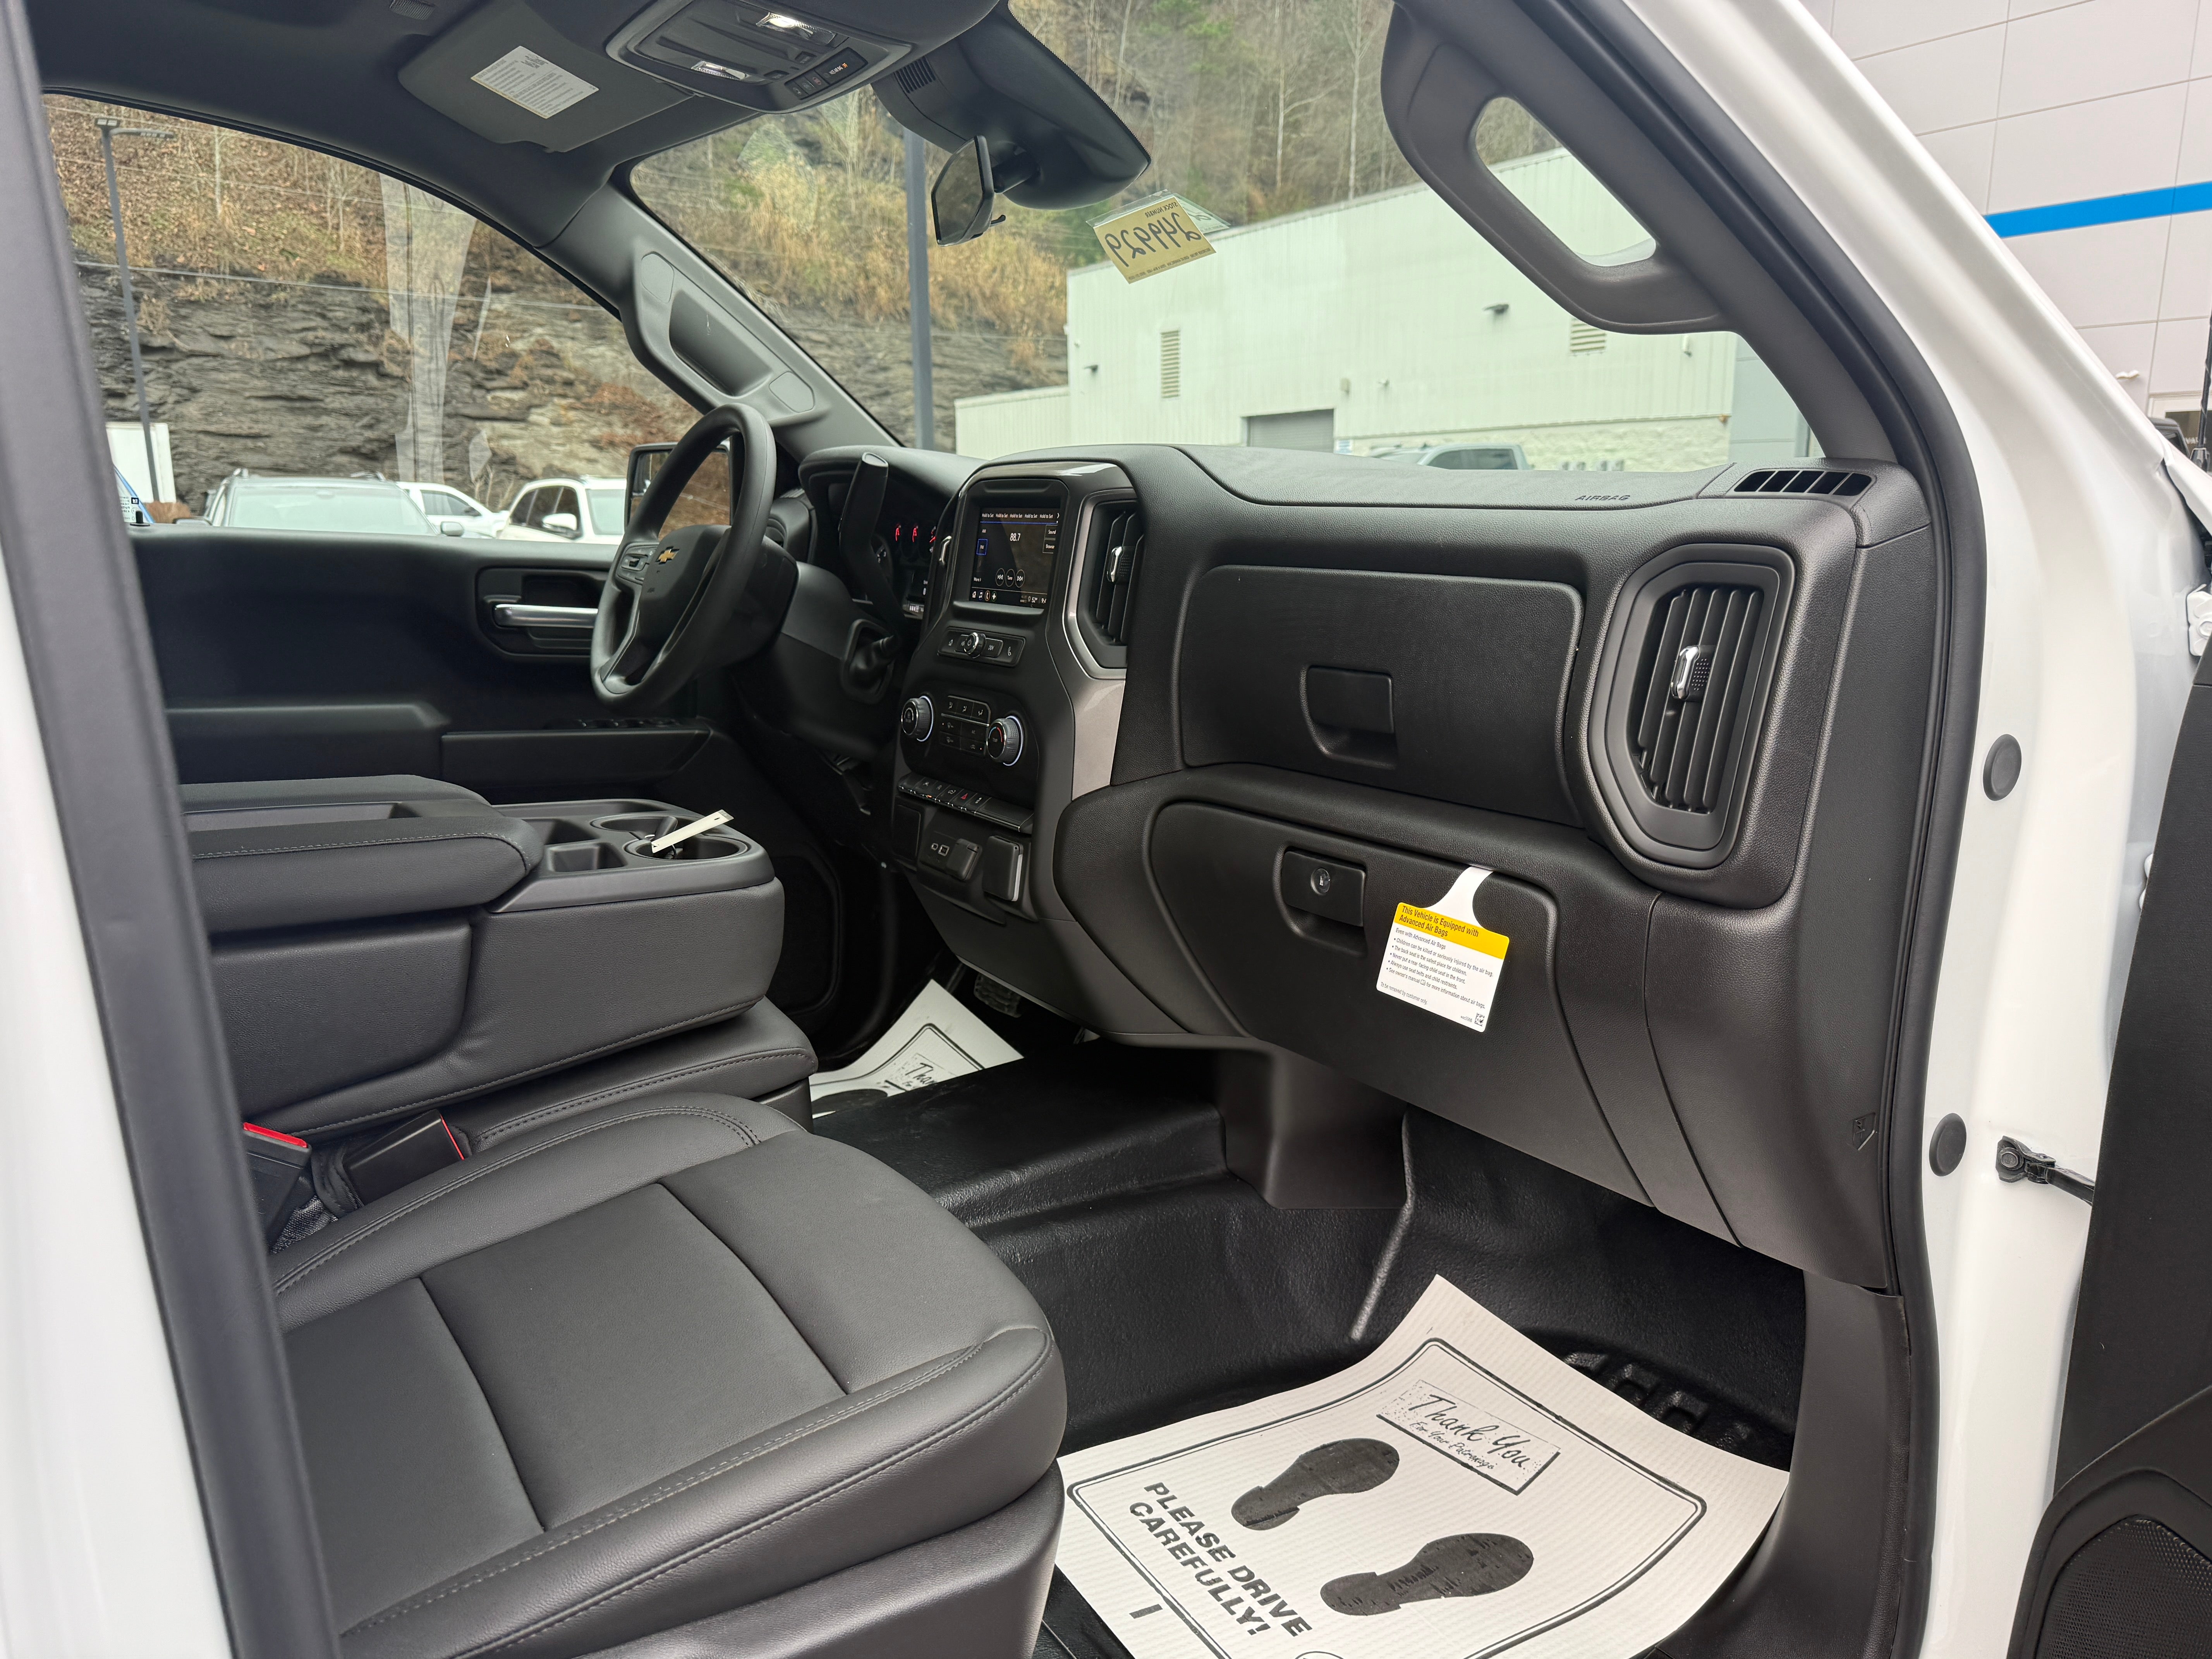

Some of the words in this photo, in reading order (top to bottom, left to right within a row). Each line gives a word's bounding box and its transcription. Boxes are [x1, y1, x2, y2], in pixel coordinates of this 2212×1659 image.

[1010, 533, 1020, 541] 88.7
[1399, 915, 1425, 929] Advanced
[1425, 923, 1434, 931] Air
[1434, 926, 1448, 937] Bags
[1402, 905, 1413, 915] This
[1414, 909, 1433, 922] Vehicle
[1440, 918, 1465, 933] Equipped
[1467, 928, 1479, 937] with
[1413, 934, 1431, 944] Advanced
[1408, 1394, 1500, 1441] Thank
[1487, 1435, 1531, 1468] You
[1410, 1421, 1428, 1432] For
[1427, 1431, 1450, 1444] Your
[1448, 1442, 1496, 1469] Patronage
[1129, 1502, 1271, 1636] CAREFULLY!
[1144, 1482, 1236, 1562] PLEASE
[1227, 1565, 1313, 1637] DRIVE
